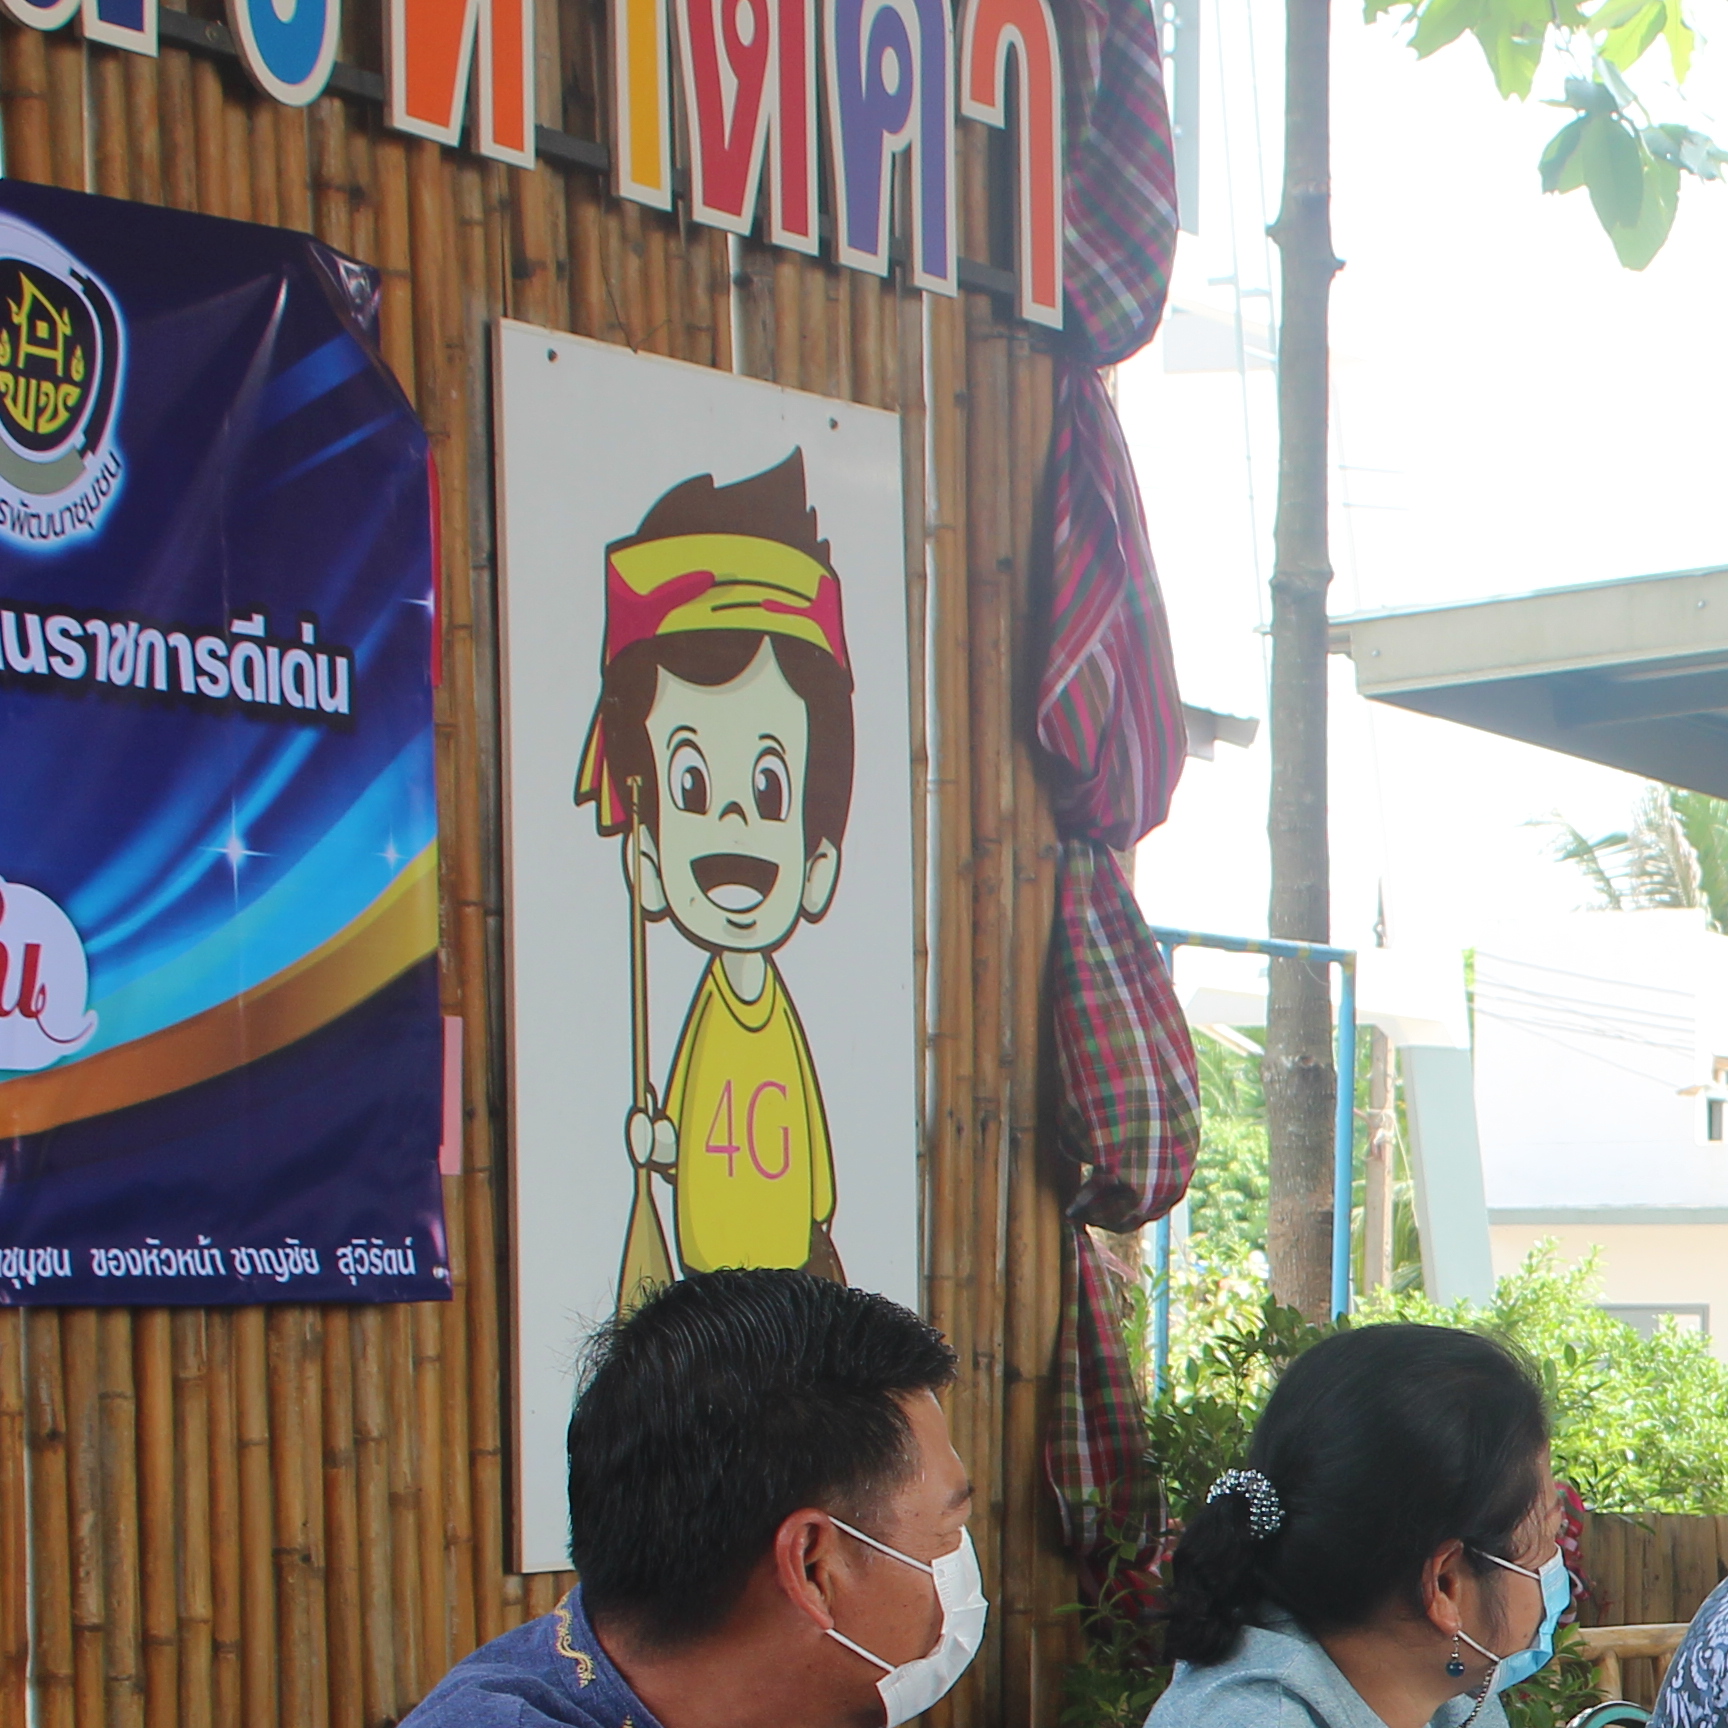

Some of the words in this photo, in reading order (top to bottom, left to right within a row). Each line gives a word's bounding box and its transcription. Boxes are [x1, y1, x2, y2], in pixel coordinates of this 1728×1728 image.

[0, 610, 349, 714] นราชการดีเด่น
[705, 1079, 789, 1180] 4G
[0, 1246, 71, 1290] ชุมชน
[91, 1235, 224, 1277] ของหัวหน้า
[232, 1237, 319, 1282] ชาญชัย
